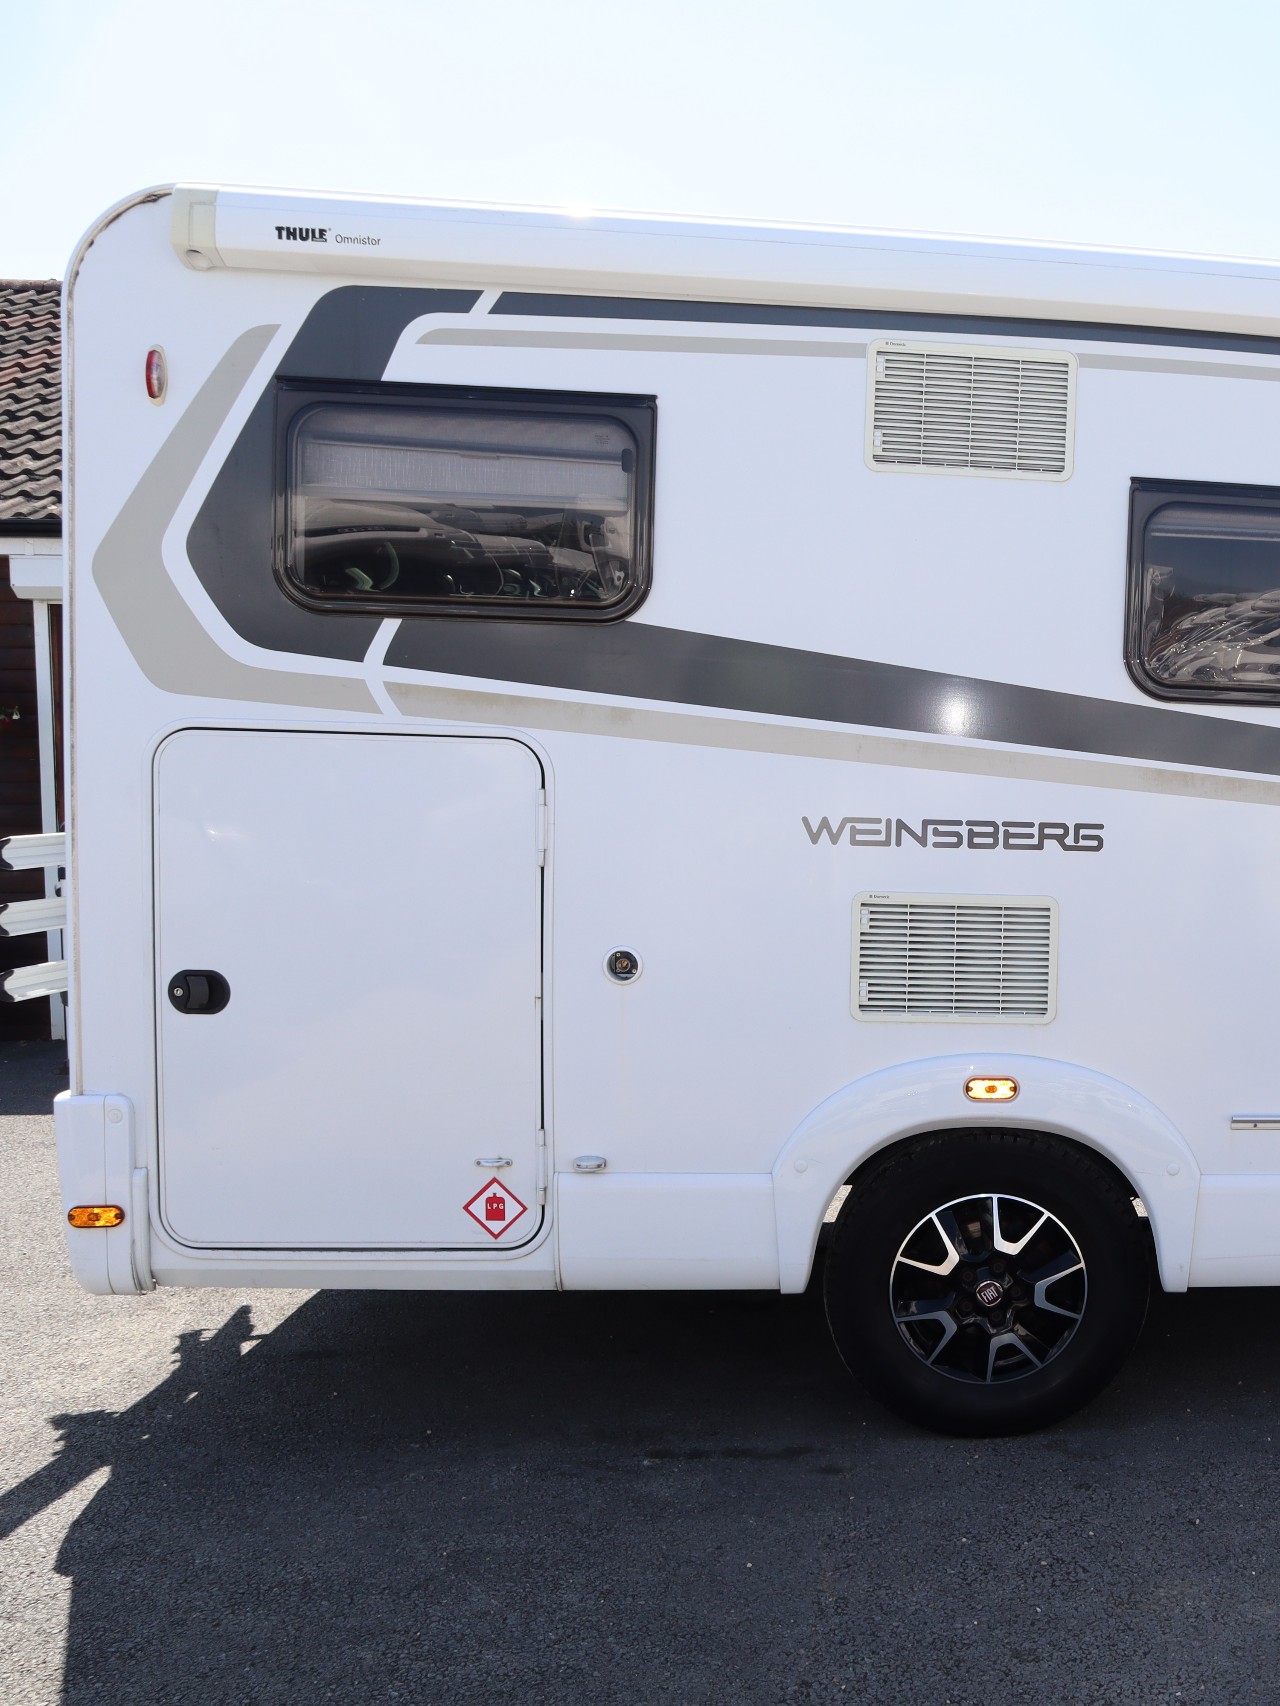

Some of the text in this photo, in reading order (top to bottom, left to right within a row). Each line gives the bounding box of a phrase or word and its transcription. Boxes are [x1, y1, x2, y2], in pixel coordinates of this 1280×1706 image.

[275, 226, 381, 246] THULE Omnistor
[801, 816, 1105, 852] WEINSBERG
[980, 1285, 999, 1303] FIAT
